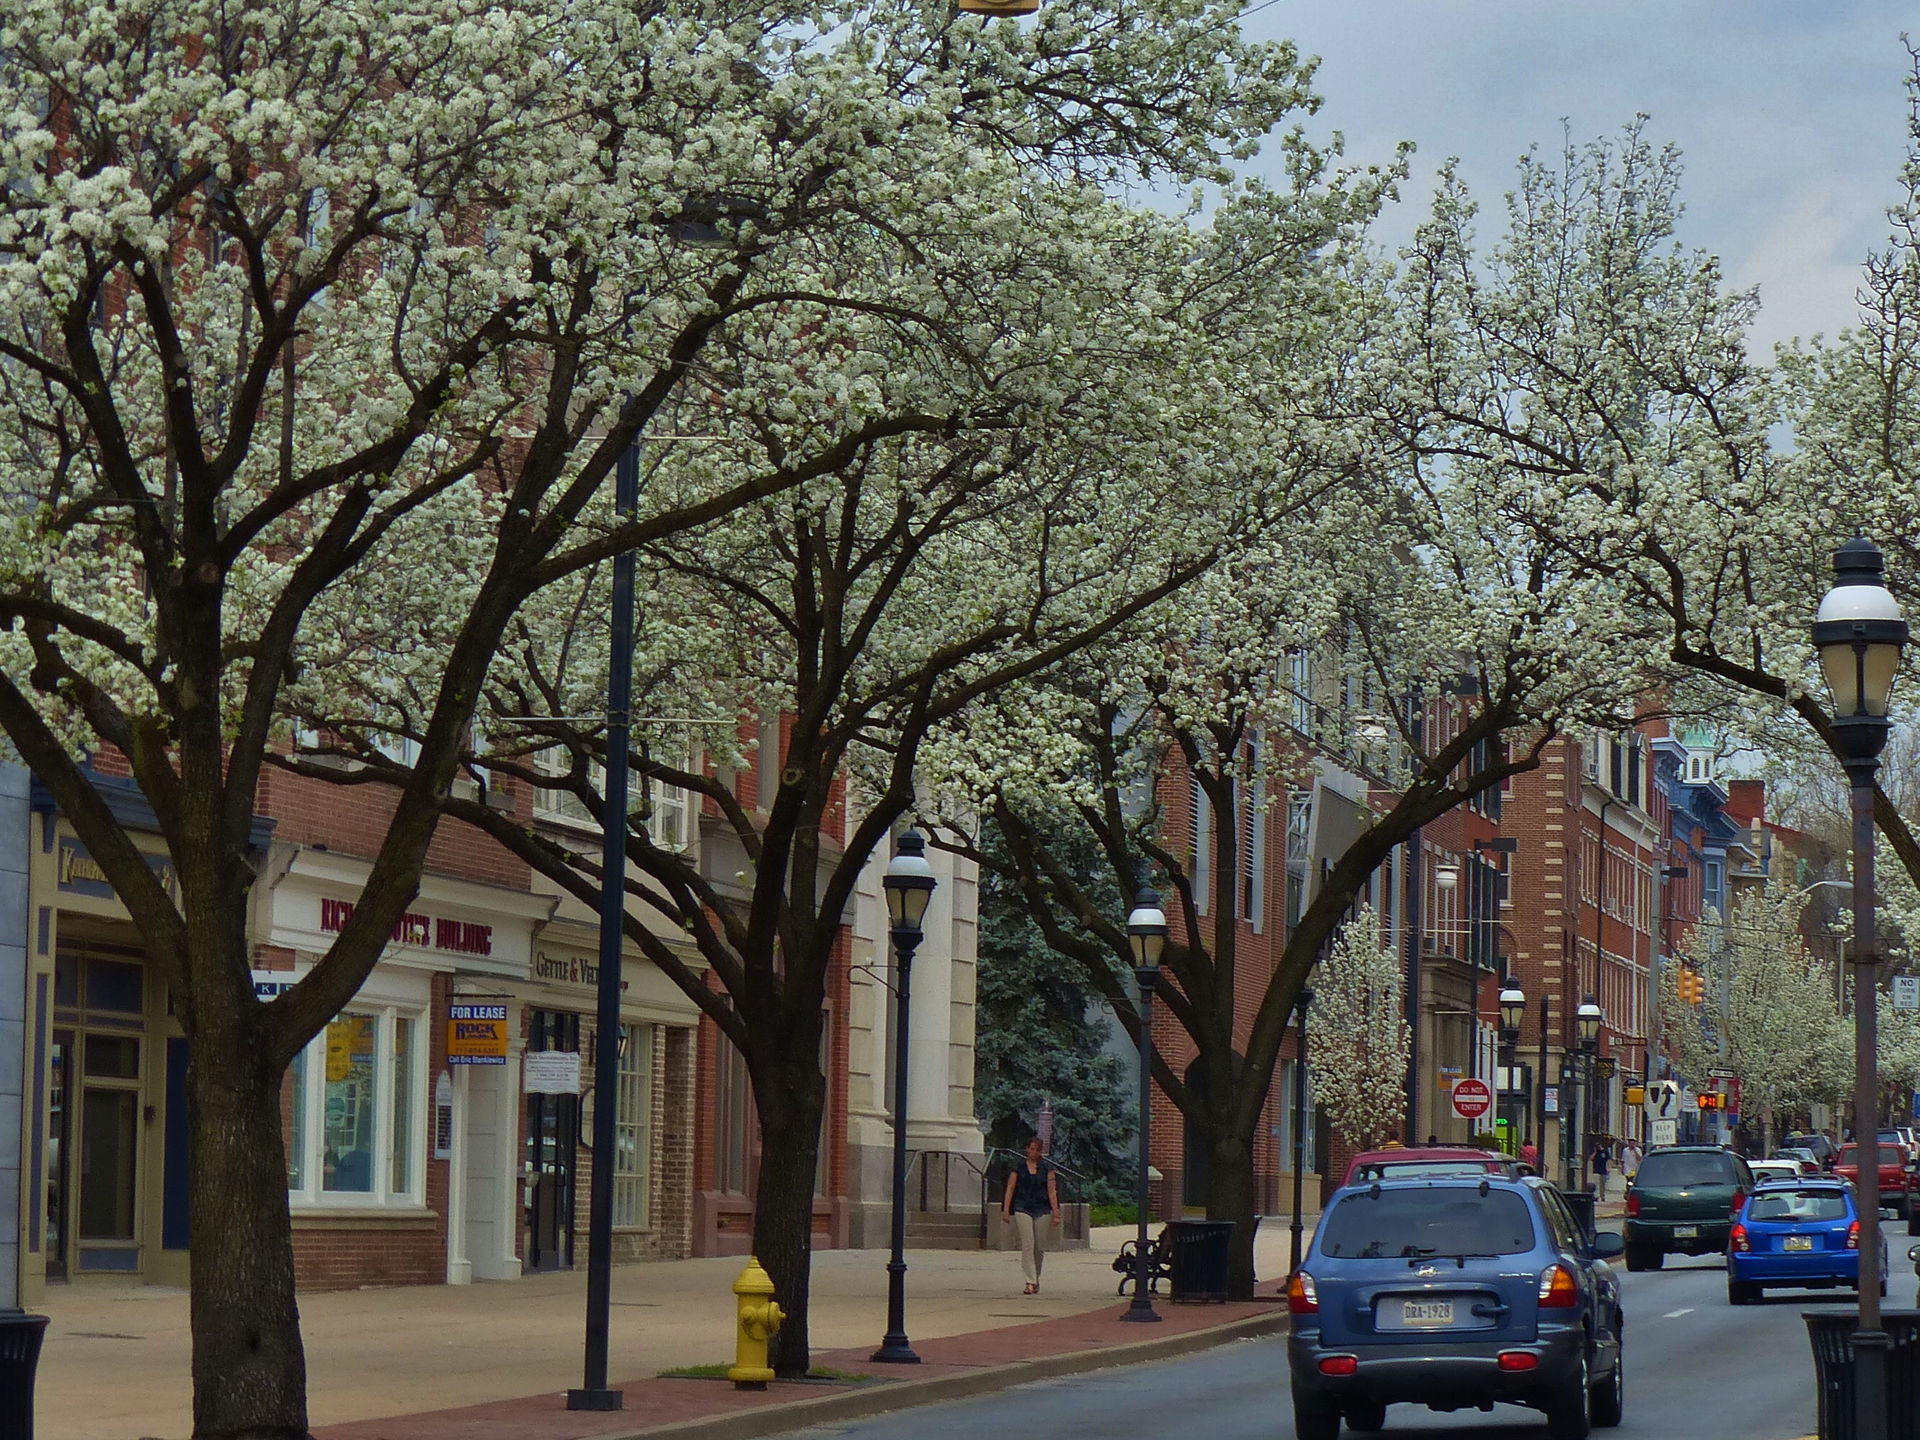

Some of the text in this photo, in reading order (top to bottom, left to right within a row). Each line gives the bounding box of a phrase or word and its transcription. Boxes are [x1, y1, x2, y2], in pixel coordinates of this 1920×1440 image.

[435, 917, 492, 956] BUILDING
[570, 957, 578, 982] &
[1900, 979, 1914, 987] NO
[451, 1006, 505, 1019] FOR LEASE
[455, 1022, 499, 1040] ROCK
